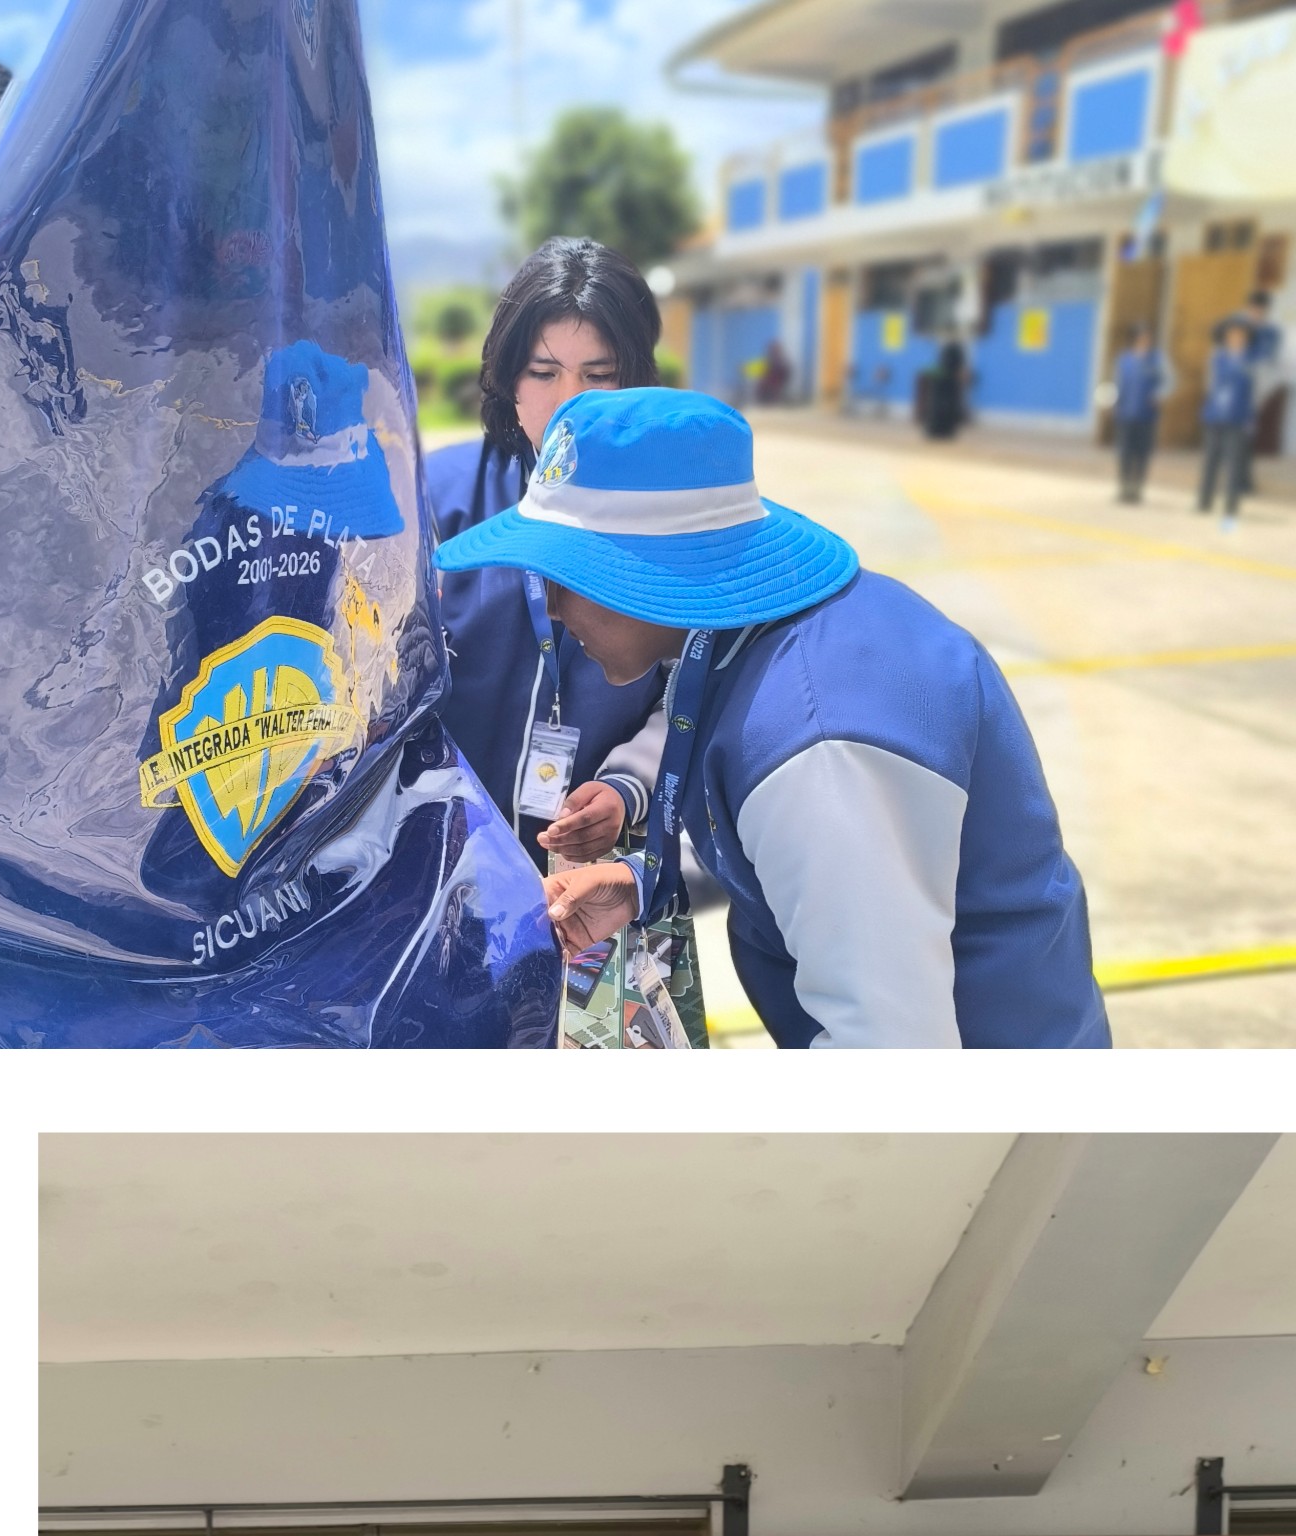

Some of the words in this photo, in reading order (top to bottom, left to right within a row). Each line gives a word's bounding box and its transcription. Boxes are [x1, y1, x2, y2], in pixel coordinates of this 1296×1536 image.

[142, 515, 264, 602] BODAS
[271, 505, 298, 538] DE
[306, 508, 377, 580] PLATA
[237, 551, 321, 585] 2001-2026
[169, 722, 250, 773] INTEGRADA
[192, 880, 312, 965] SICUANI
